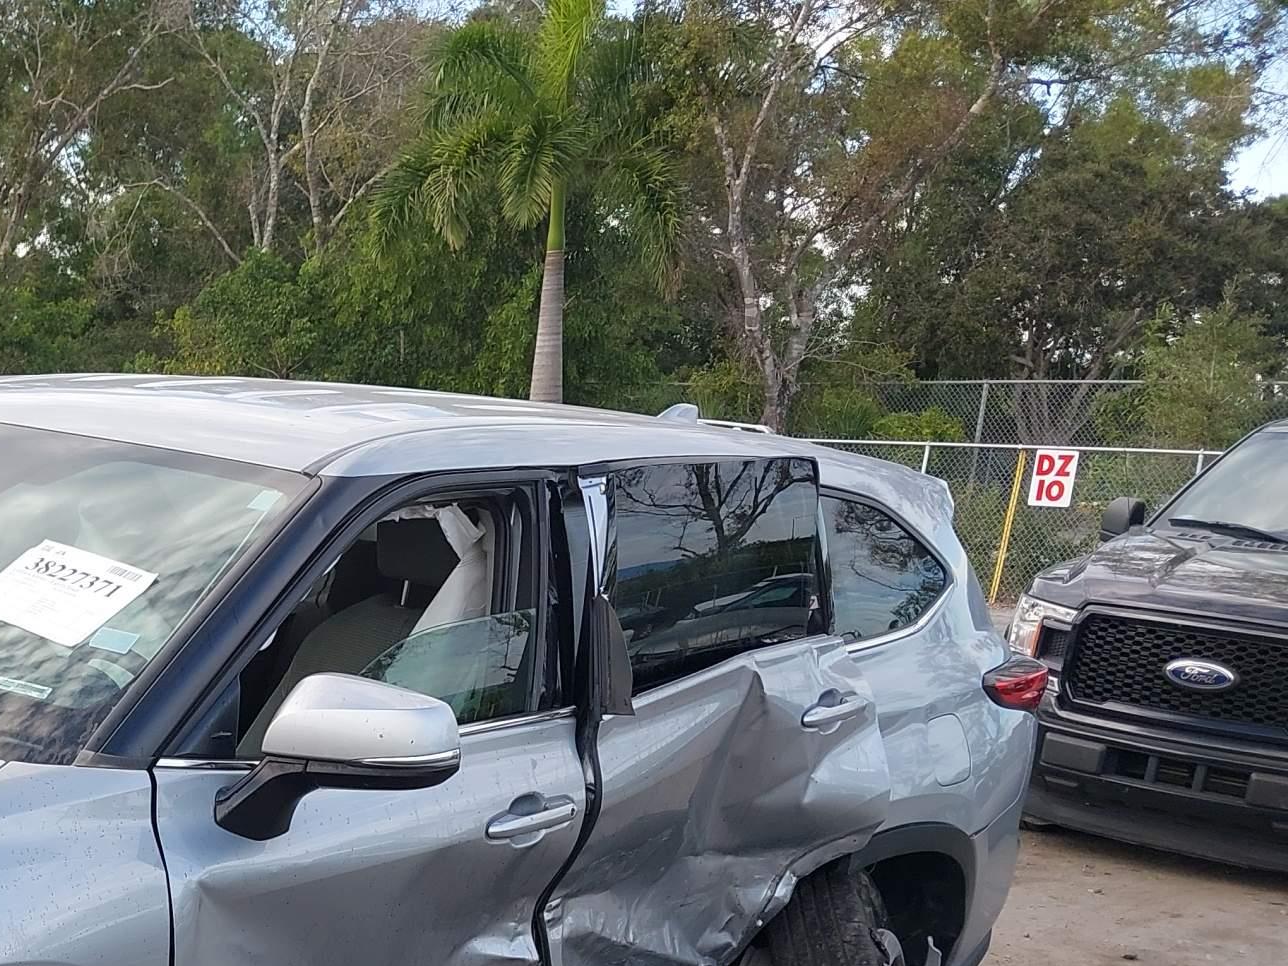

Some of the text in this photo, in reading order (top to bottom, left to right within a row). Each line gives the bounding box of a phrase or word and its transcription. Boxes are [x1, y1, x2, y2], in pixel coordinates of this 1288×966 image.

[1035, 454, 1075, 477] DZ
[24, 556, 123, 598] 38227371
[1179, 666, 1218, 684] Ford
